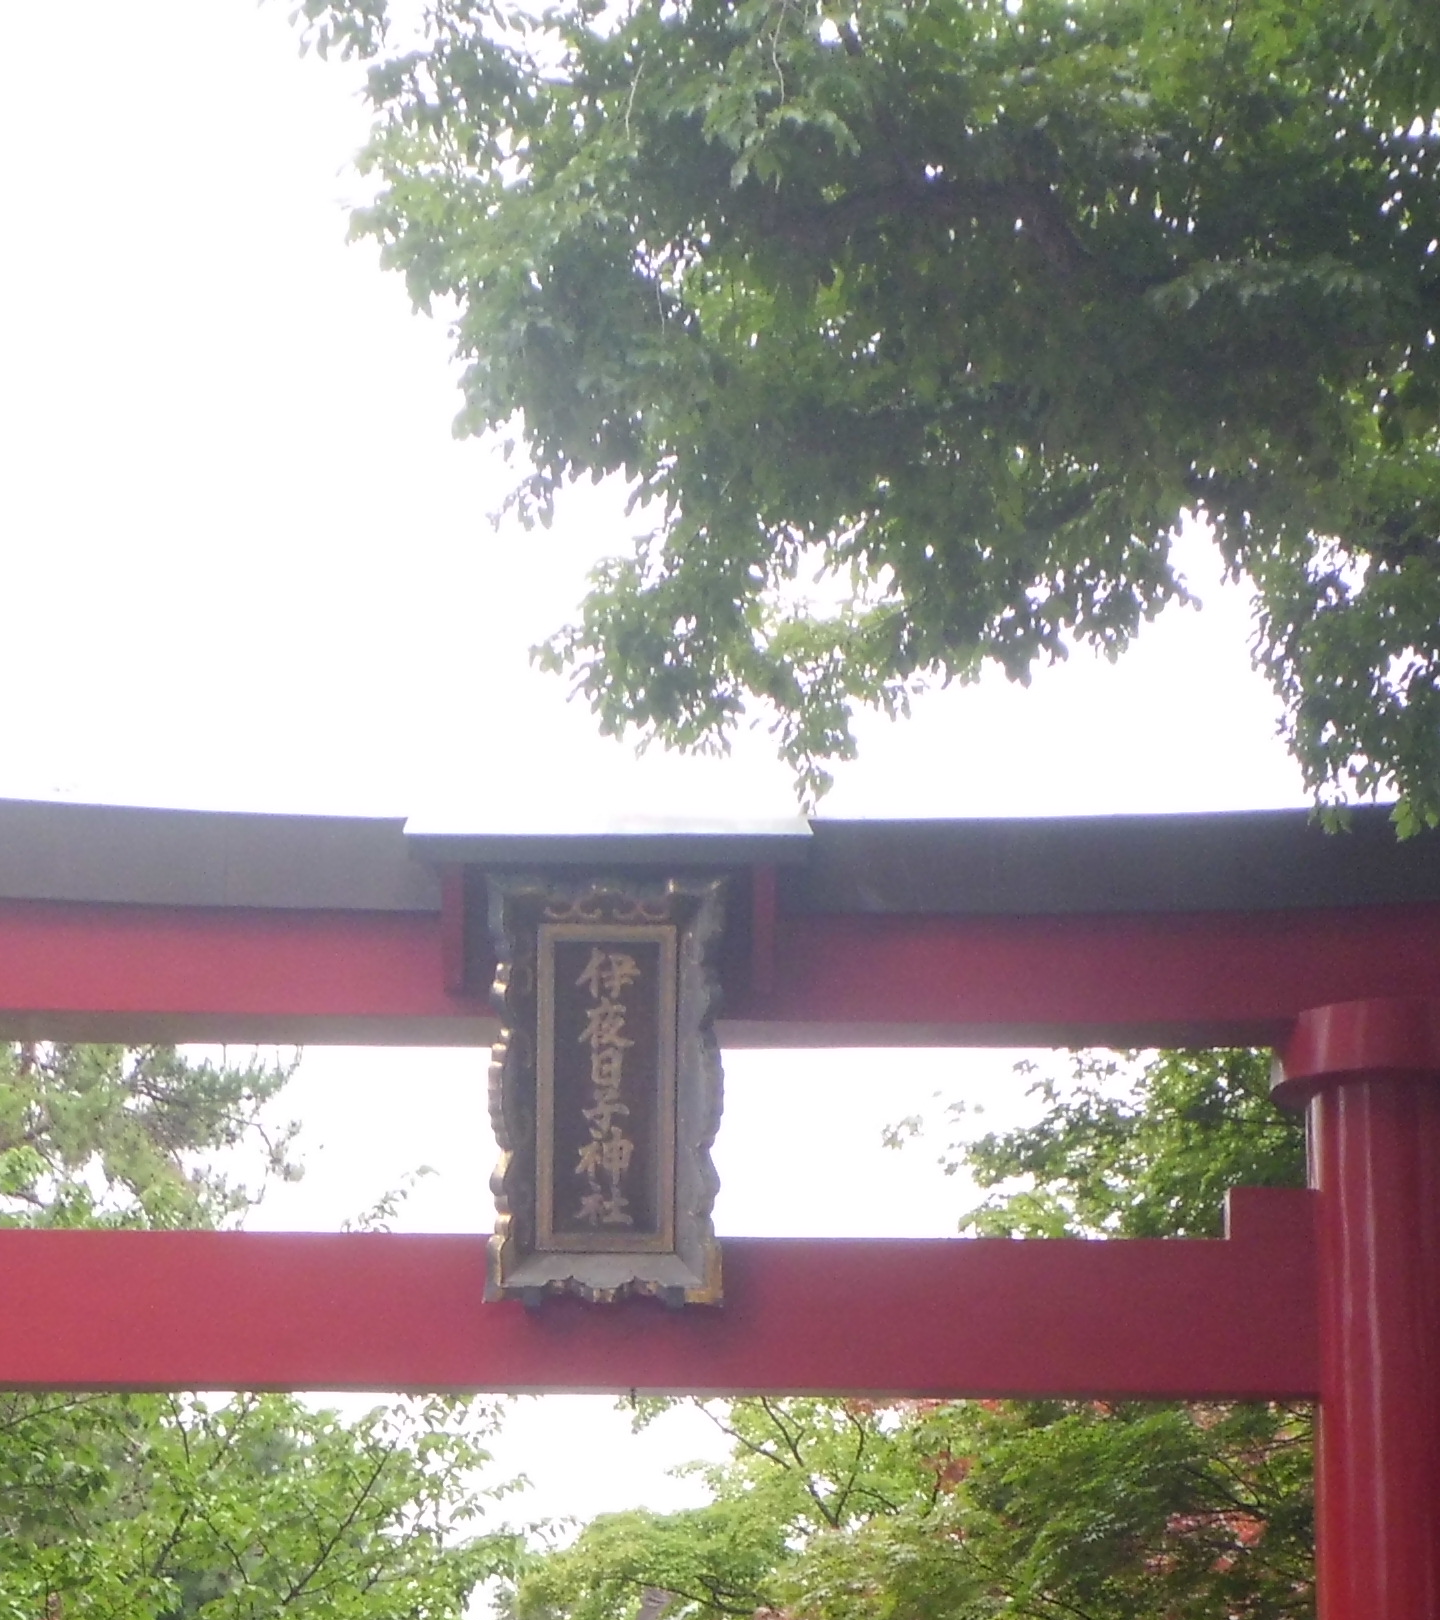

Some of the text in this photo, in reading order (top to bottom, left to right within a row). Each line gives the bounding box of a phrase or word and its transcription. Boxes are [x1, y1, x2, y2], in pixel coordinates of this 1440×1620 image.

[576, 947, 641, 1226] 伊夜日子神社
